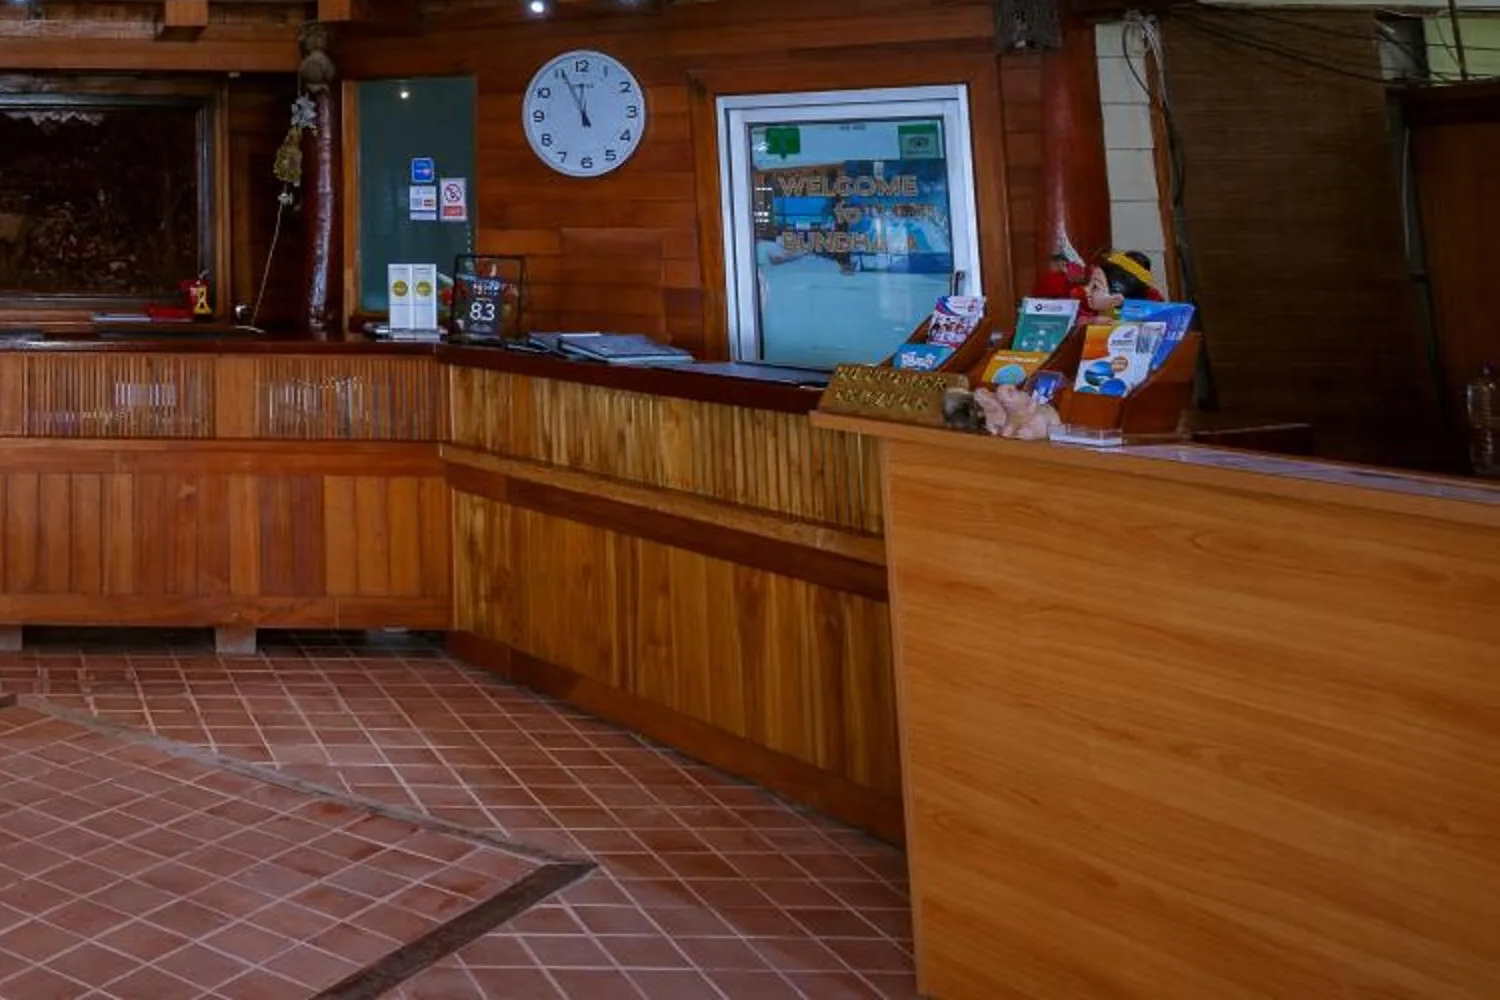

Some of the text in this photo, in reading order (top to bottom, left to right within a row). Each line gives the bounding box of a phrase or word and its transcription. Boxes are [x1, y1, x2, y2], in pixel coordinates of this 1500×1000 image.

[575, 60, 589, 72] 12
[537, 87, 551, 98] 10
[619, 81, 631, 93] 2
[533, 109, 544, 122] 9
[627, 105, 638, 119] 3
[542, 133, 552, 147] 8
[620, 129, 631, 142] 4
[556, 151, 567, 163] 7
[605, 149, 617, 161] 5
[580, 156, 593, 169] 6
[777, 175, 918, 197] WELCOME
